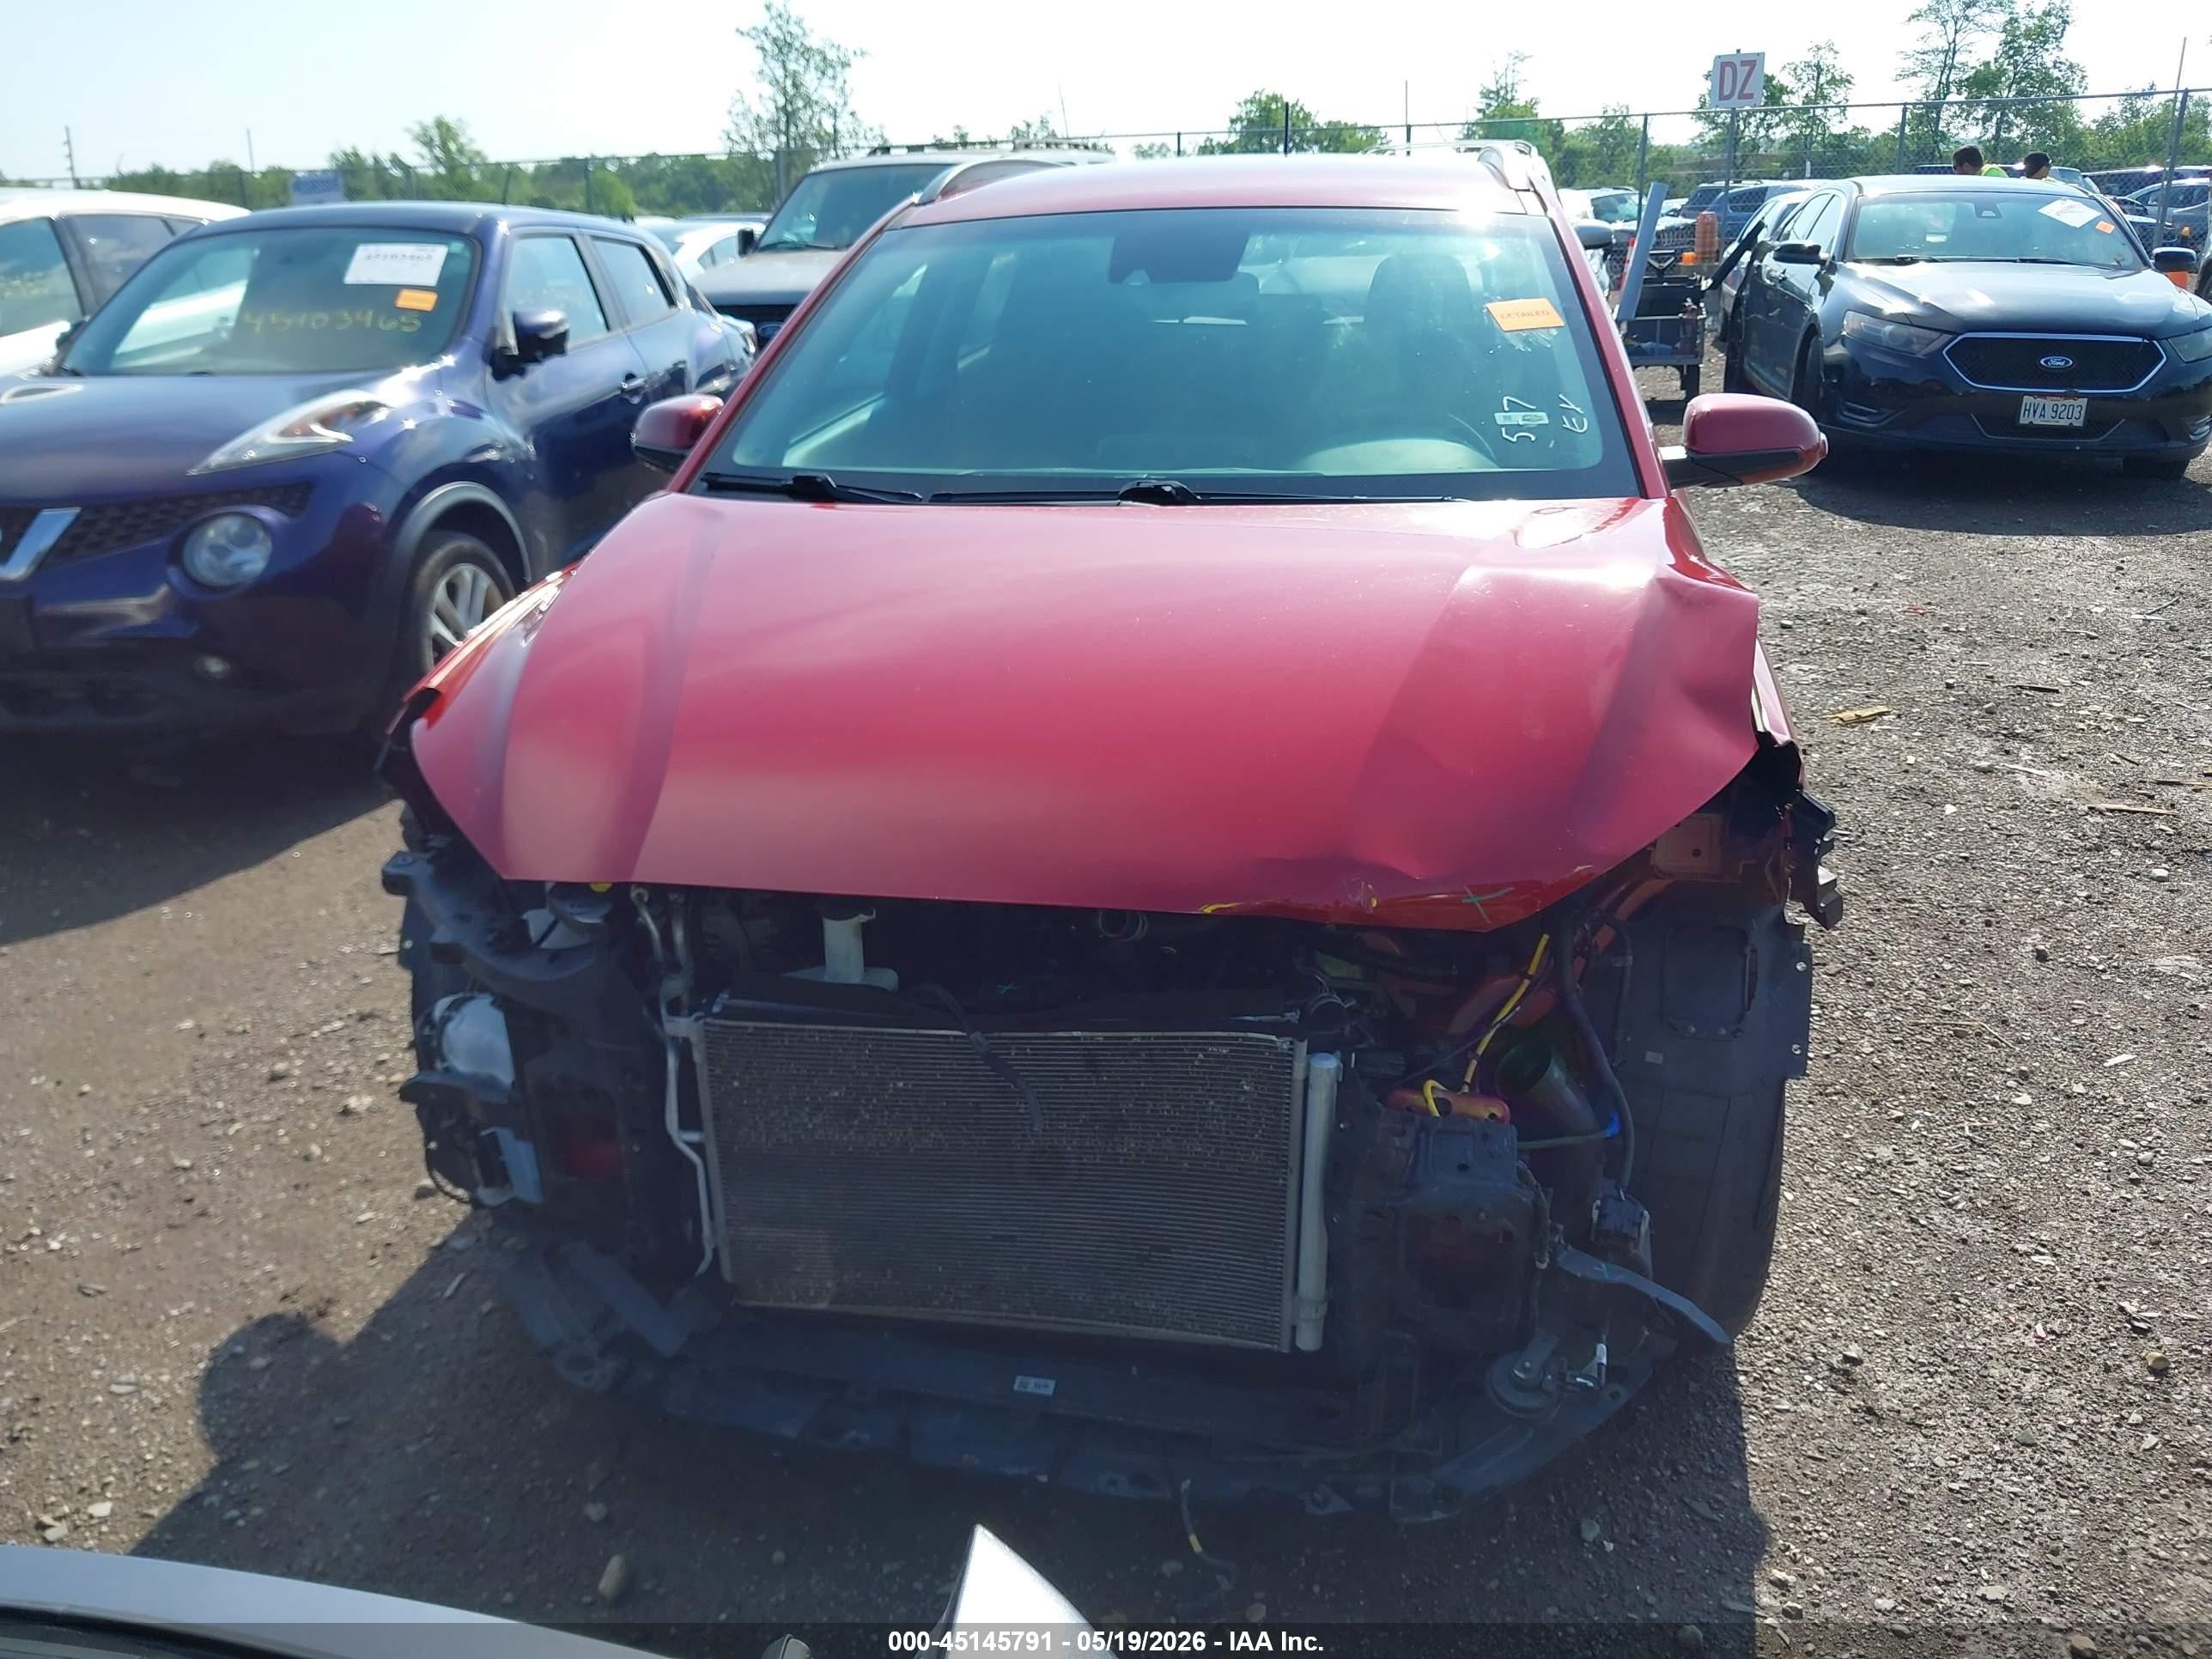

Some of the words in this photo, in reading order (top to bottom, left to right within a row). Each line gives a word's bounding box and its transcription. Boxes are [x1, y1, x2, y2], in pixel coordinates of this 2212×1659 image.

[1718, 59, 1757, 101] DZ
[242, 308, 422, 334] 45103465
[2022, 402, 2046, 419] HVA
[2051, 403, 2084, 421] 9203
